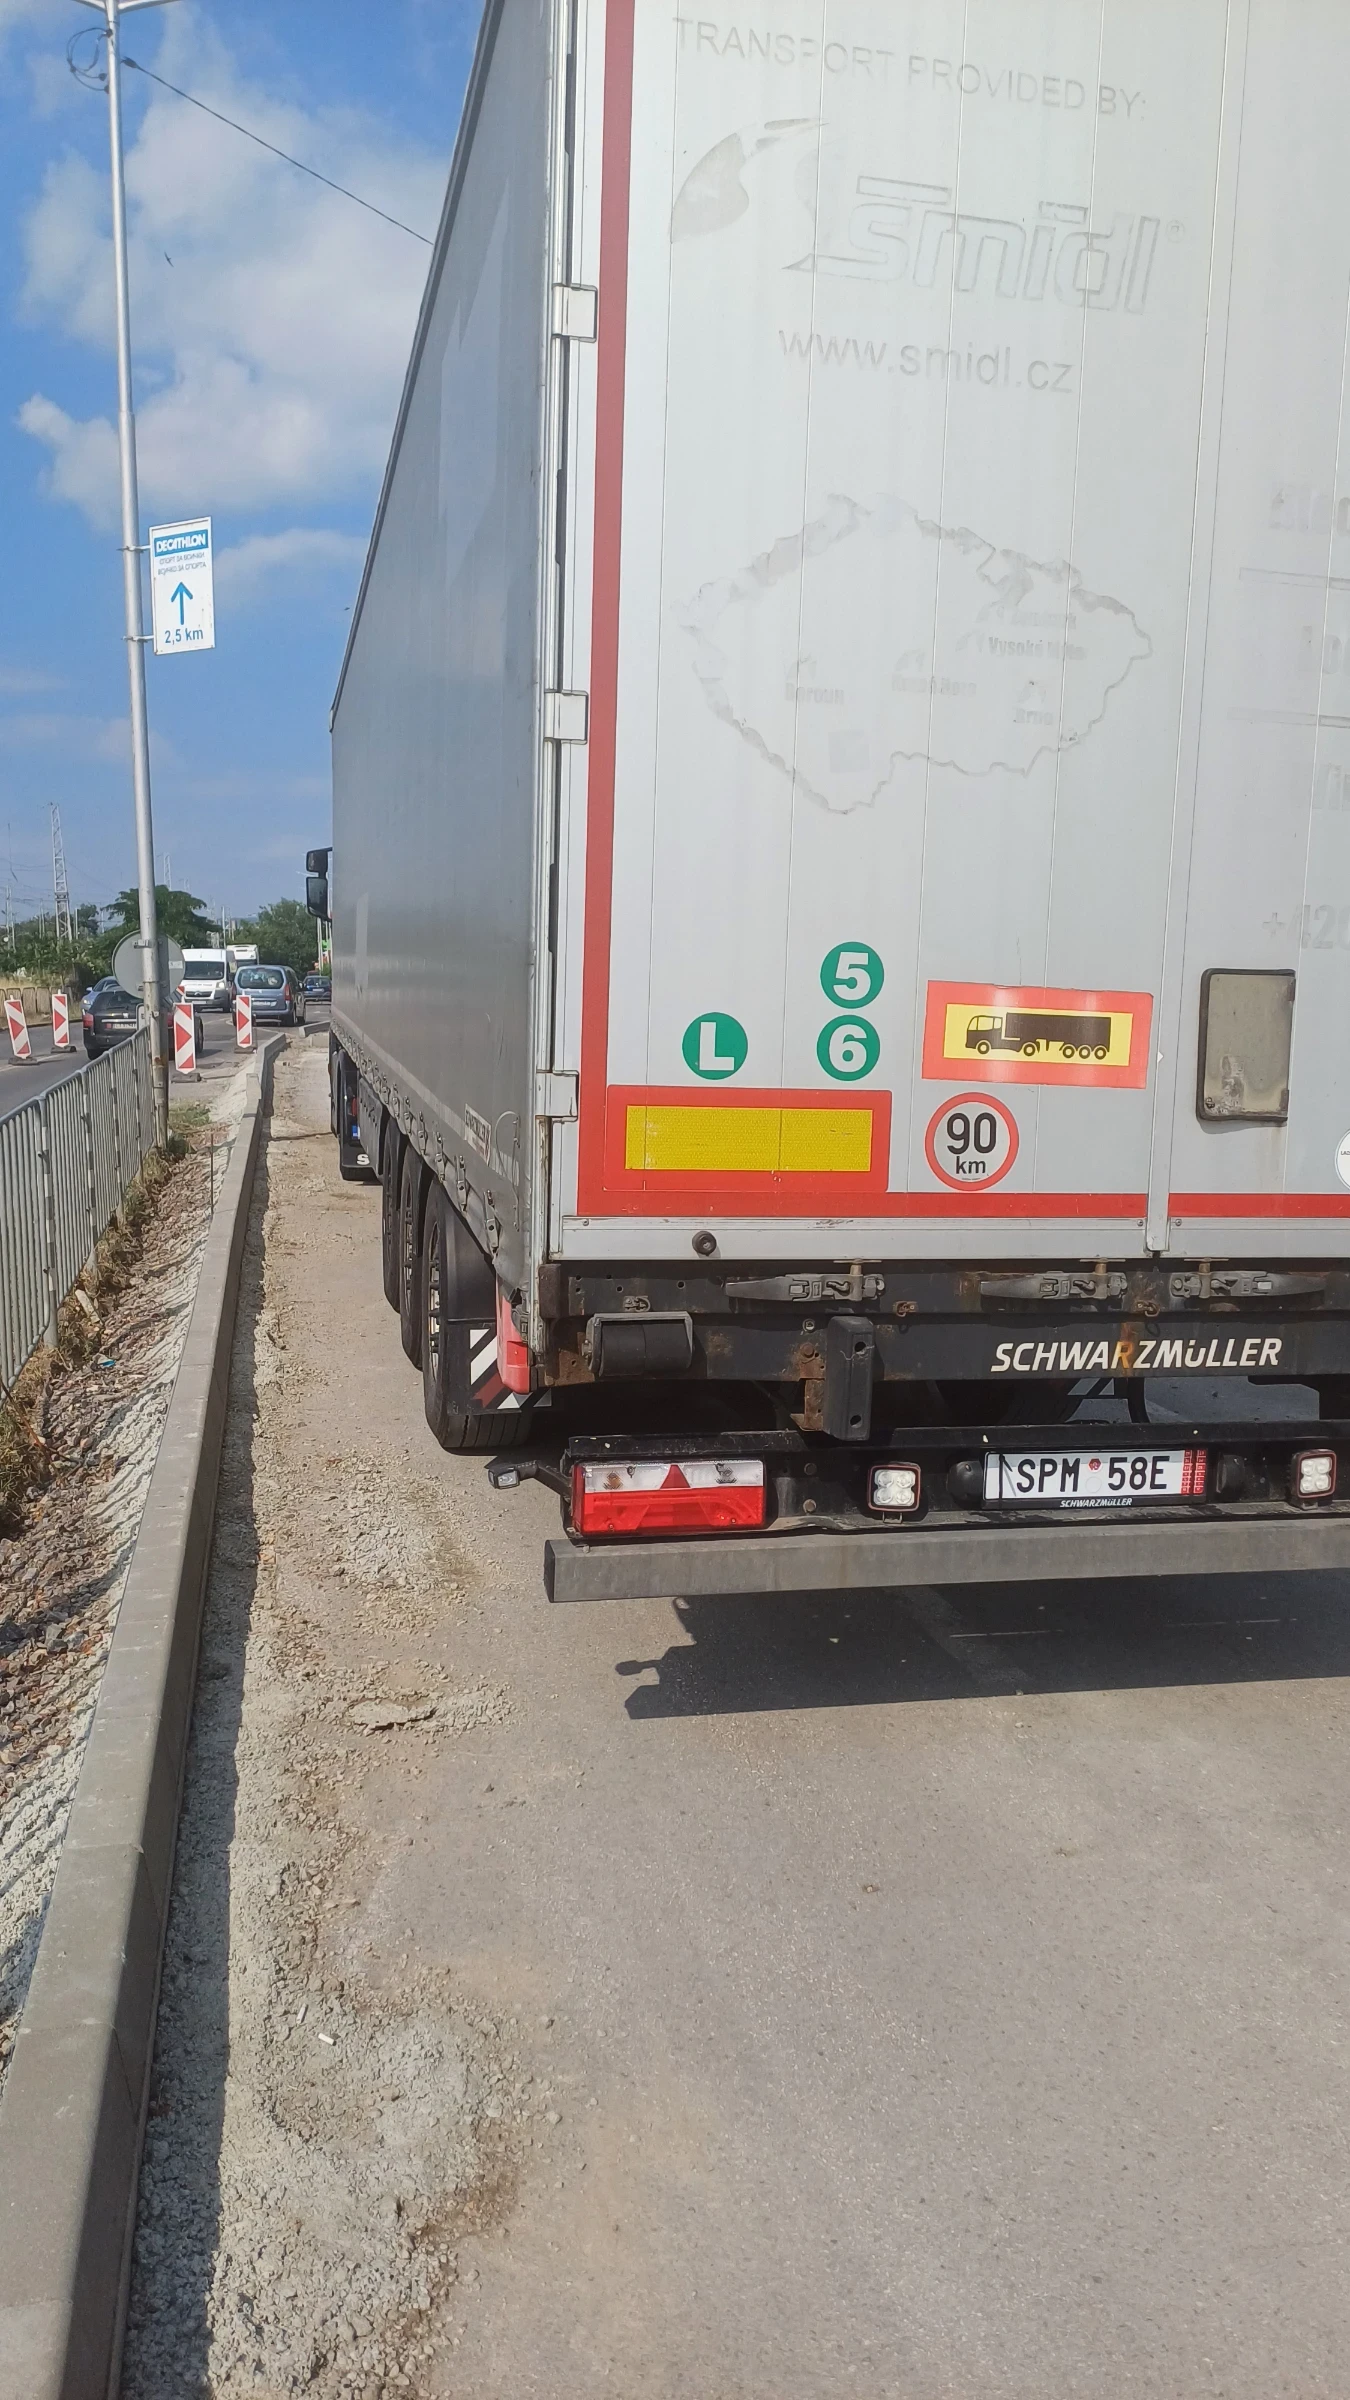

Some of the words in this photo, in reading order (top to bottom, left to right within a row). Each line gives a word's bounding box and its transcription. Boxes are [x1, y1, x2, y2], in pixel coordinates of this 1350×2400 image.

[673, 17, 897, 80] TRANSPORT
[907, 54, 1086, 110] PROVIDED
[1096, 84, 1148, 121] BY:
[777, 328, 1074, 394] www.smidl.cz
[156, 533, 206, 553] DECATHLON
[164, 628, 182, 645] 2,5
[185, 627, 204, 642] km
[834, 952, 871, 998] 5
[699, 1021, 735, 1071] L
[829, 1023, 870, 1071] 6
[946, 1112, 997, 1155] 90
[955, 1155, 986, 1174] km
[1016, 1457, 1081, 1493] SPM
[1107, 1455, 1171, 1492] 58E
